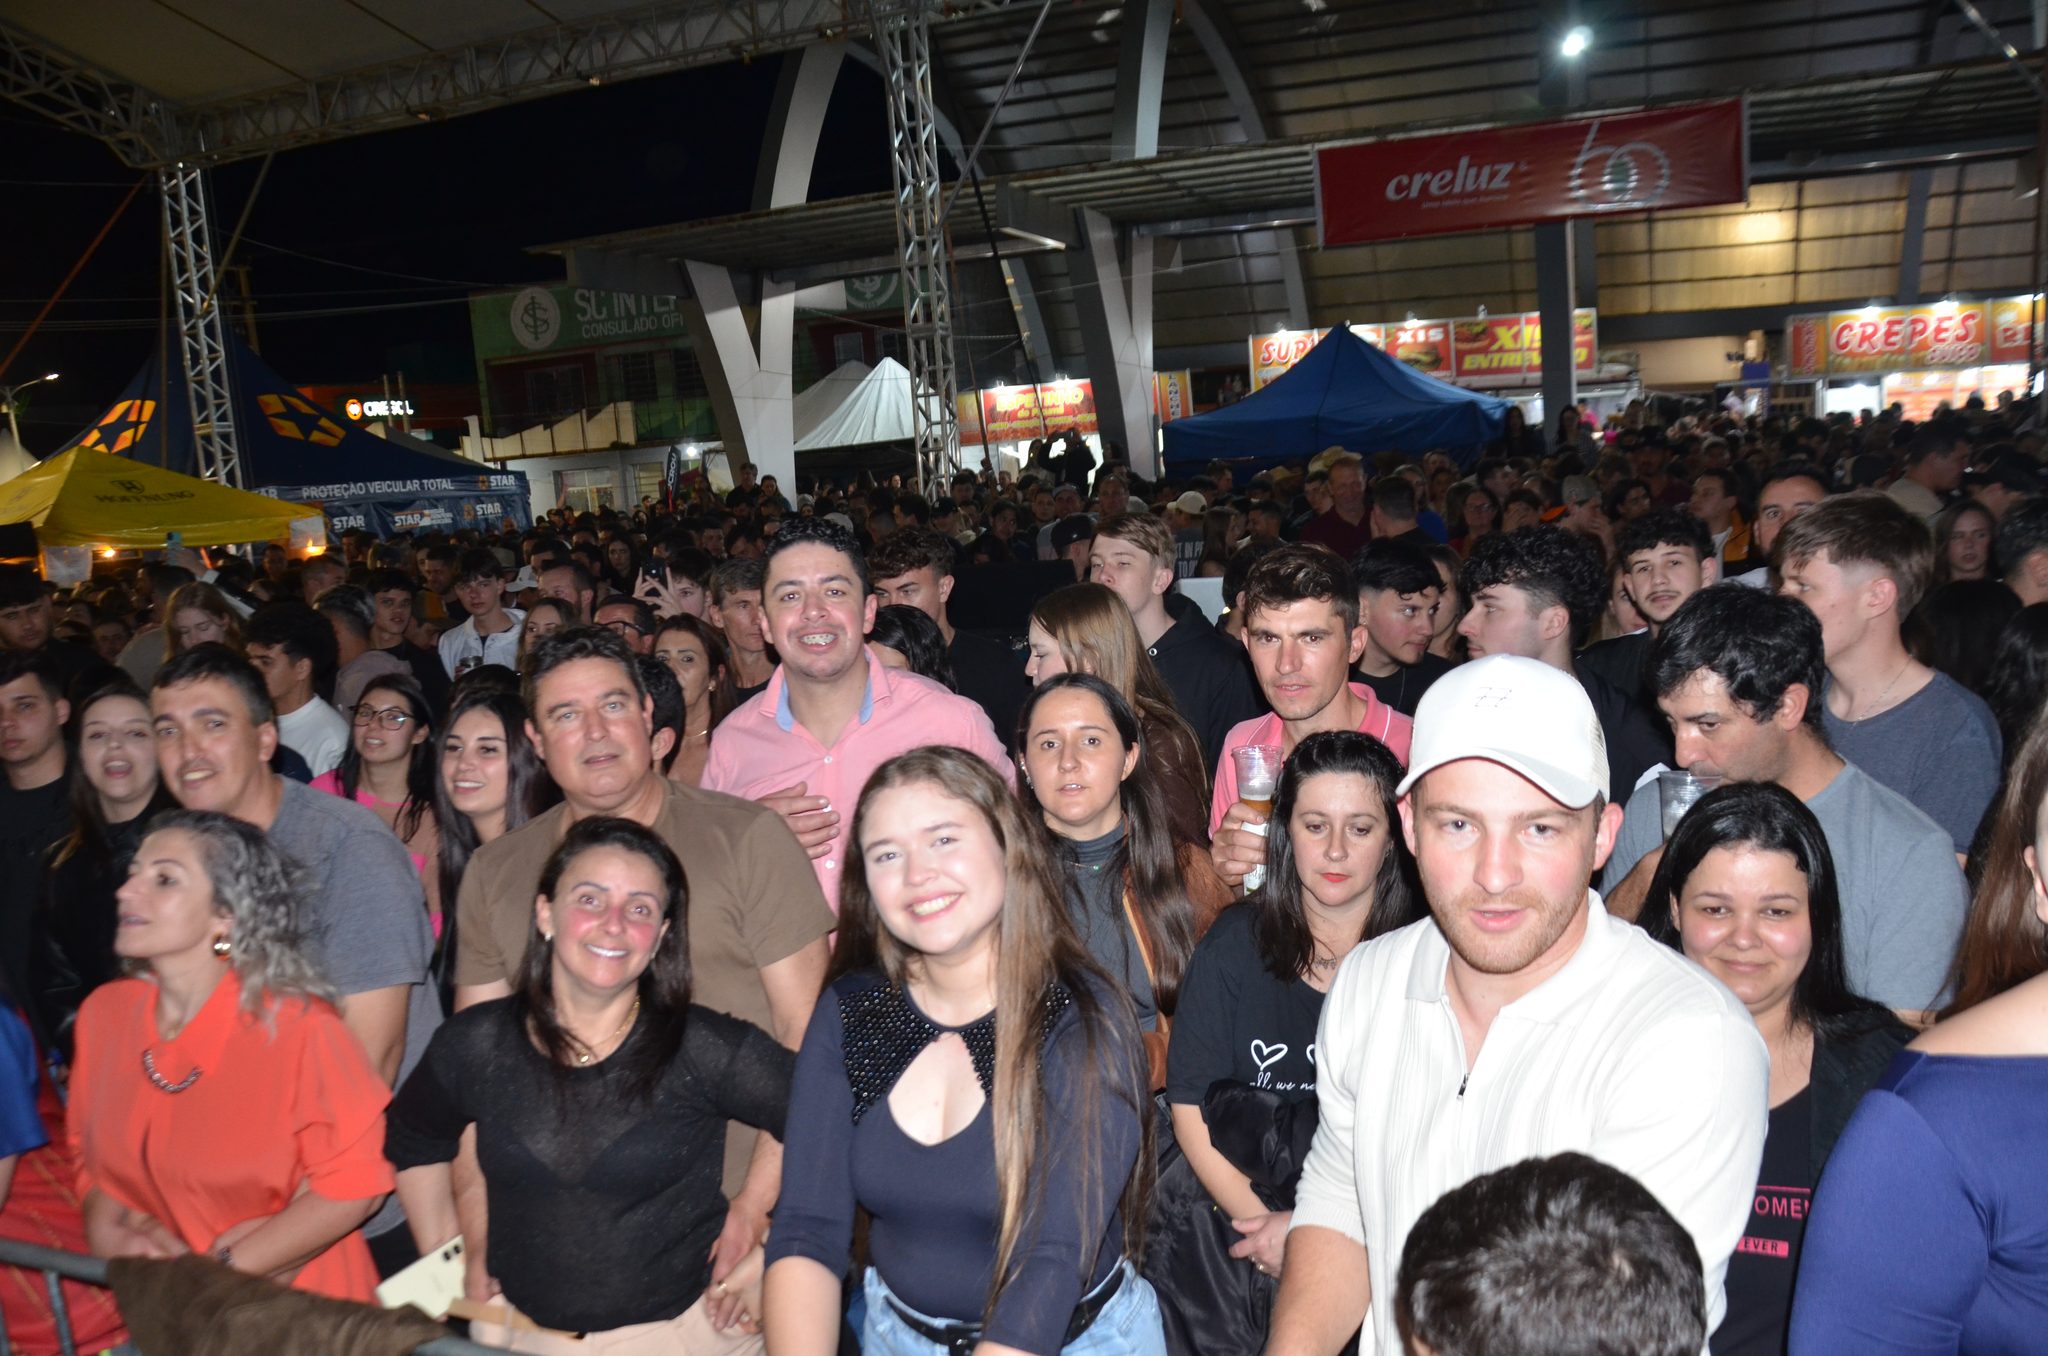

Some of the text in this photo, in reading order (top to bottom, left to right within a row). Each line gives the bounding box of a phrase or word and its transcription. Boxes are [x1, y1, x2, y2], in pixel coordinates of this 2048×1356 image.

[1385, 155, 1516, 201] creluz
[582, 316, 658, 339] CONSULADO
[1831, 309, 1980, 355] CREPES
[1397, 327, 1445, 345] XIS
[367, 478, 421, 494] VEICULAR
[422, 478, 455, 491] TOTAL
[489, 475, 515, 488] STAR
[475, 502, 501, 516] STAR
[333, 515, 365, 530] STAR
[394, 513, 421, 527] STAR
[1276, 1081, 1296, 1090] we
[1743, 1240, 1779, 1253] EVER
